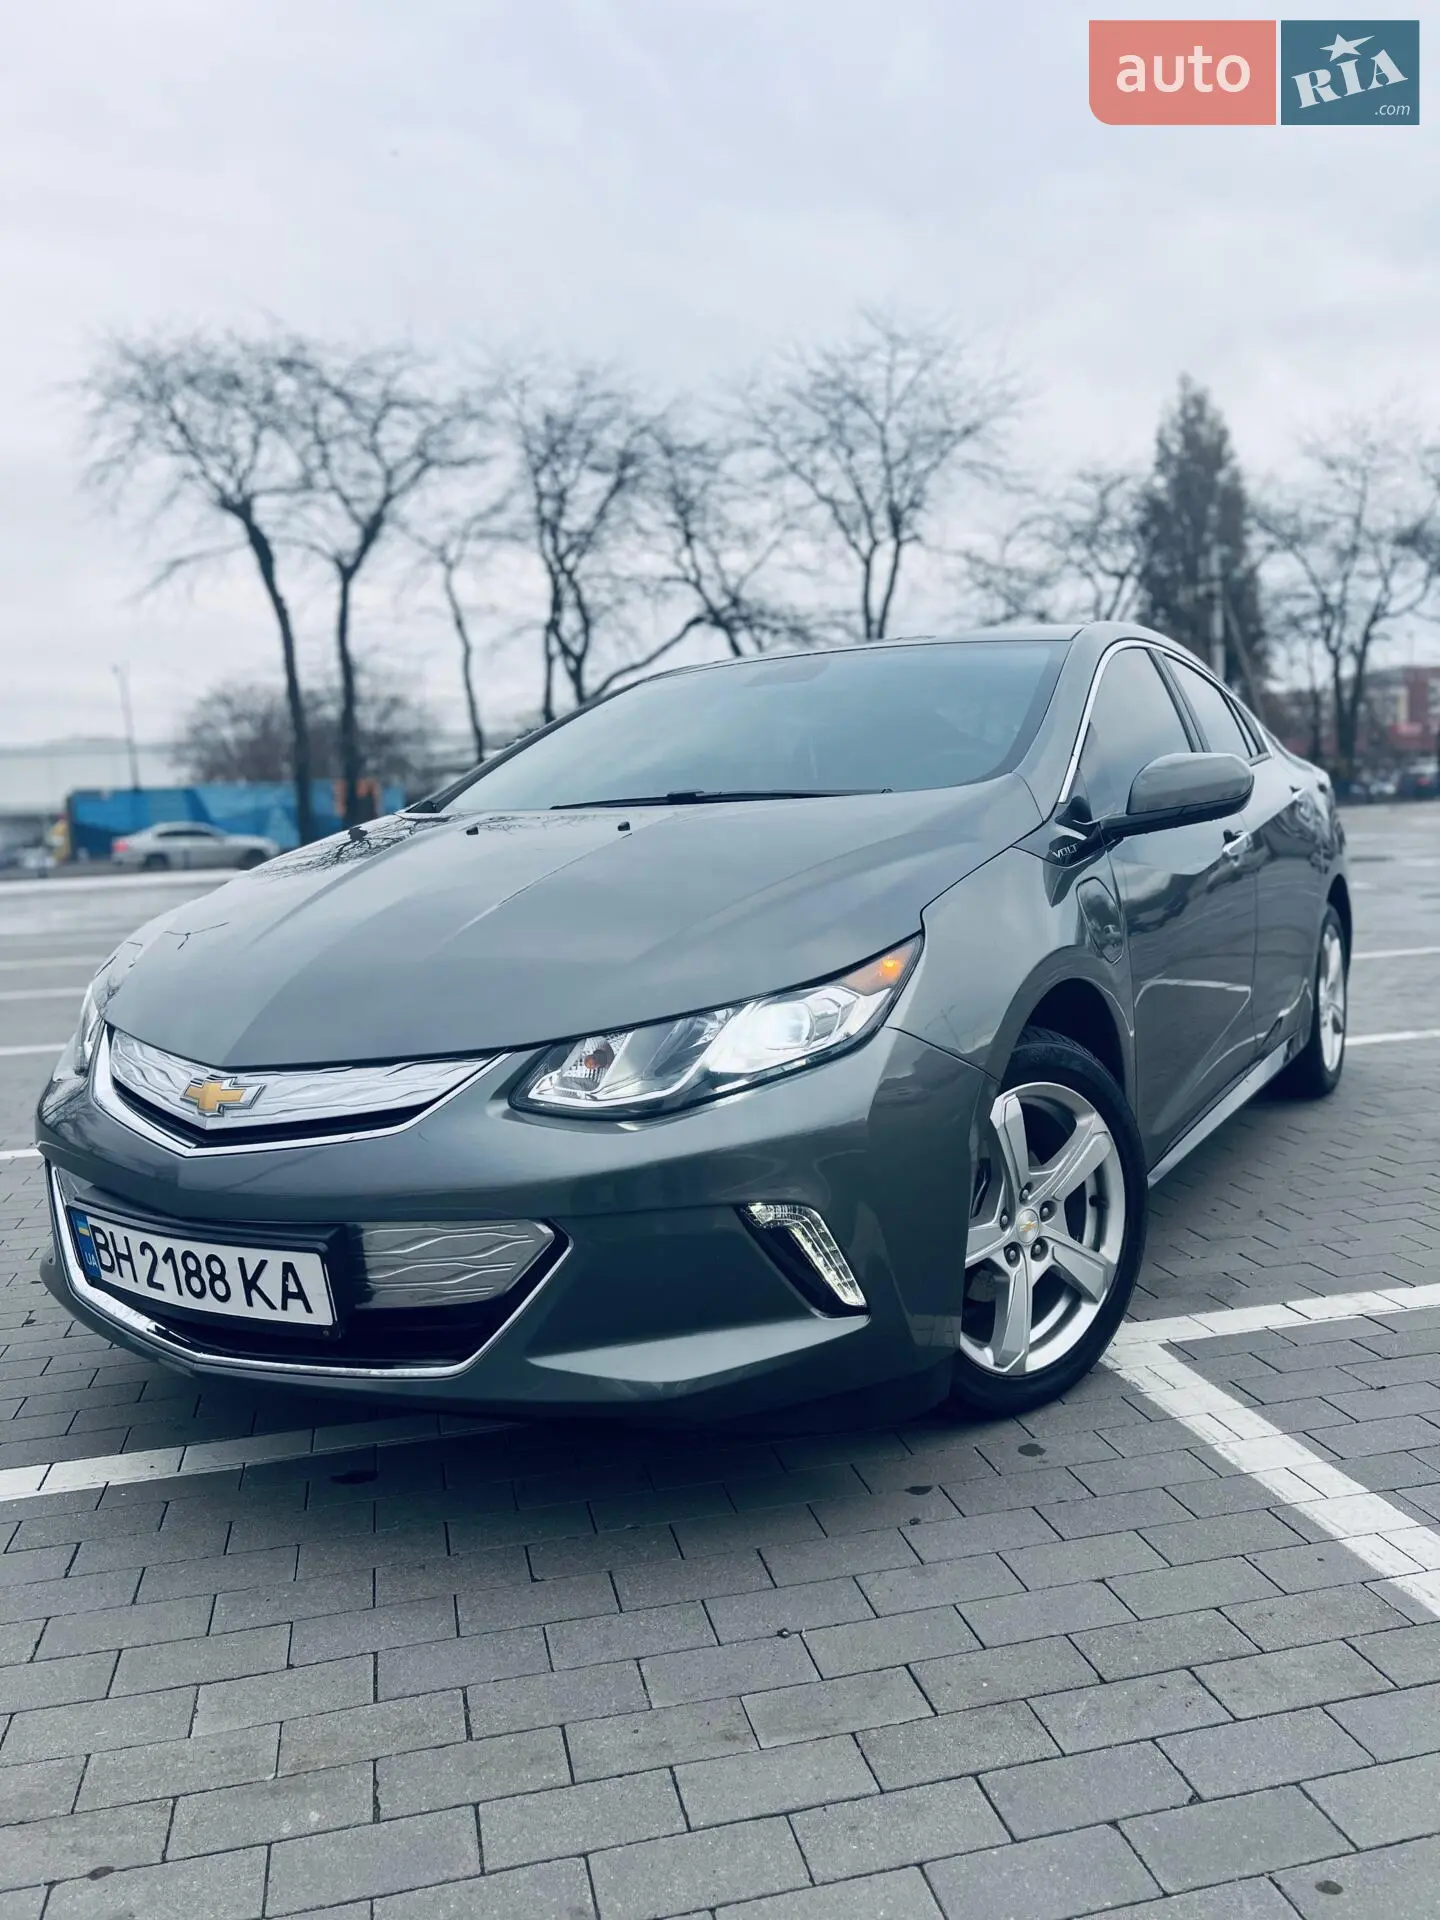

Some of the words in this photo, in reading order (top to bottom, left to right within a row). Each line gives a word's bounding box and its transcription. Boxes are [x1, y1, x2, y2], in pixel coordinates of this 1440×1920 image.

[1050, 842, 1078, 858] VOLT
[84, 1253, 98, 1269] UA
[139, 1240, 232, 1304] 2188
[237, 1256, 314, 1315] KA
